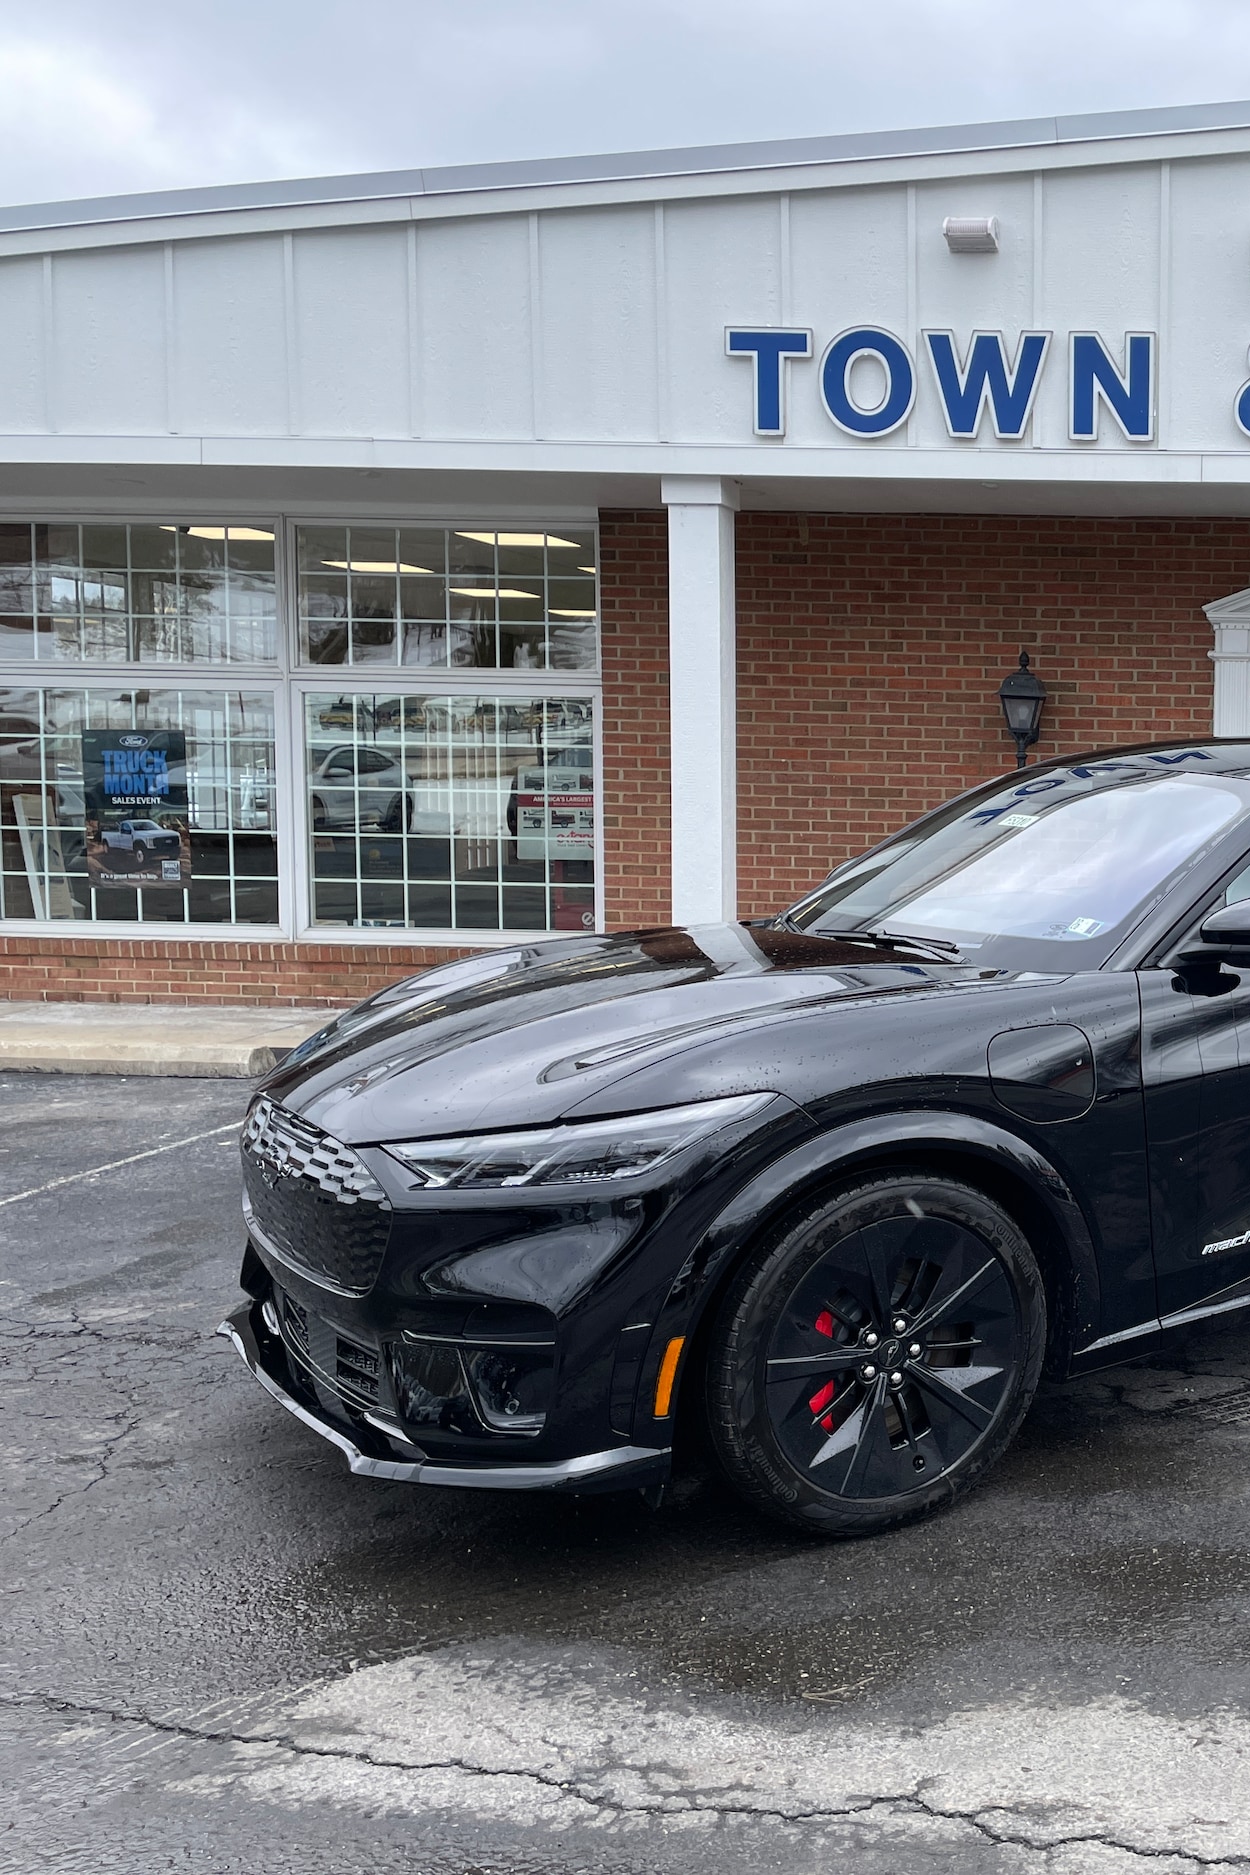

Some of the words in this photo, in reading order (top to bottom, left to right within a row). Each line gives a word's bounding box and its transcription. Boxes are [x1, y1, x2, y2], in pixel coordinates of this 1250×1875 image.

[724, 324, 1158, 443] TOWN
[101, 750, 168, 774] TRUCK
[103, 773, 170, 795] MONTH
[112, 797, 136, 805] SALES
[136, 797, 161, 805] EVENT
